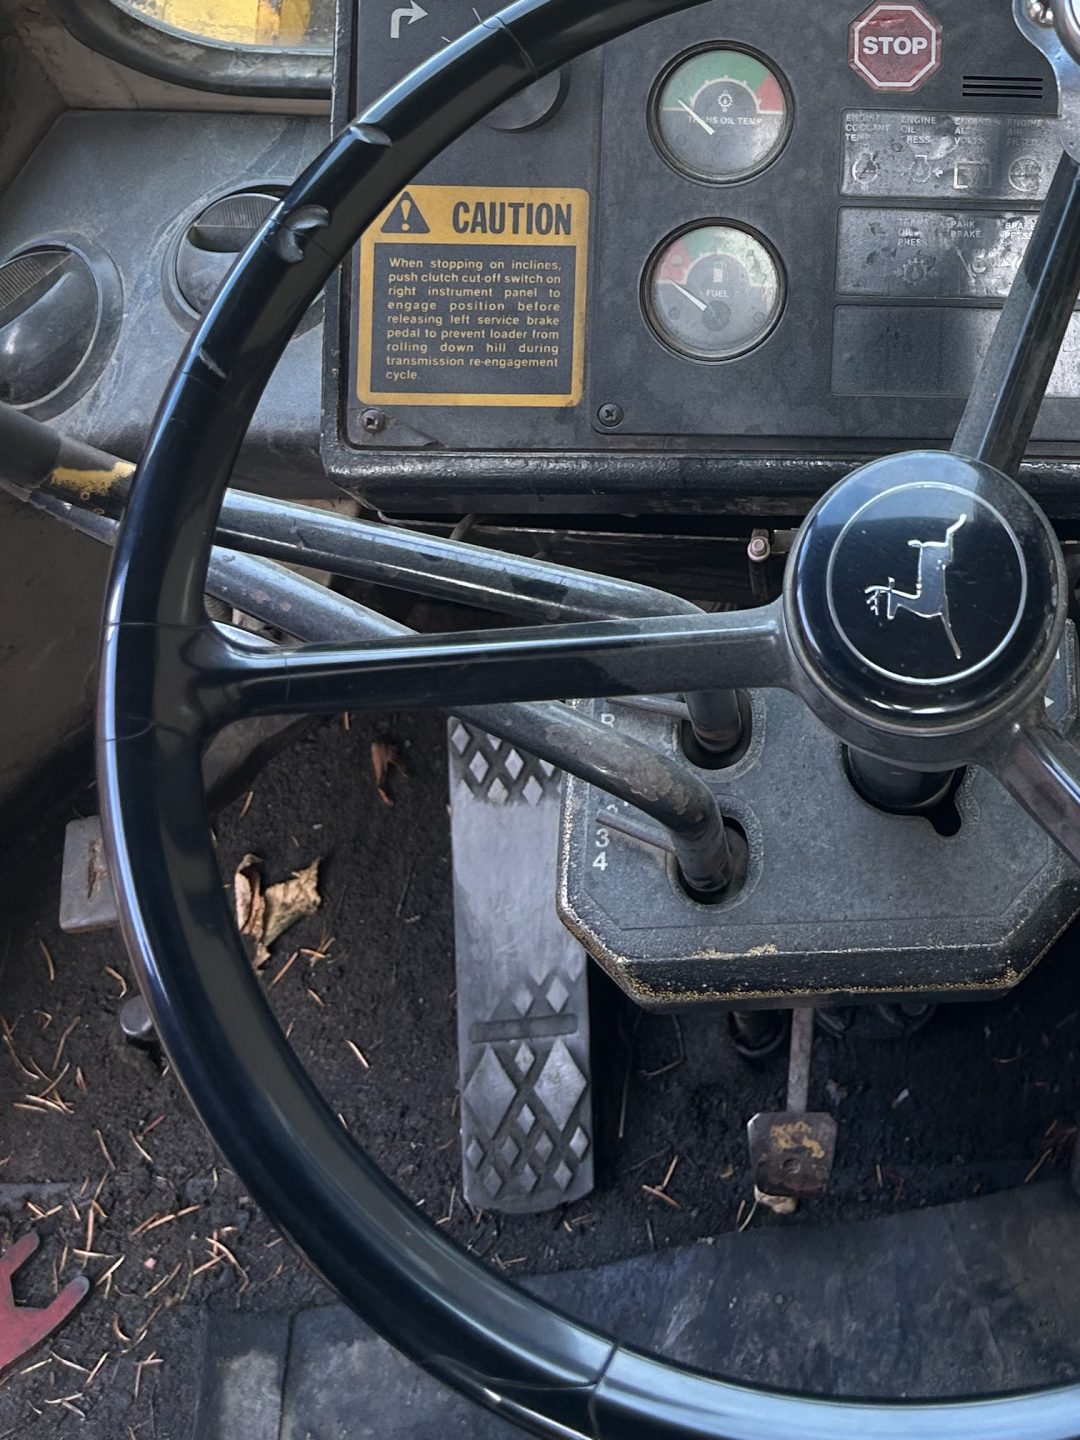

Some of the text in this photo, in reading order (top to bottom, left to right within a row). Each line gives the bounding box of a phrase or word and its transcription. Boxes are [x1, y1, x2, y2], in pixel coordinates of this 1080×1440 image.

[863, 36, 928, 55] STOP
[721, 116, 735, 124] OIL
[738, 117, 762, 125] TEMP
[900, 125, 916, 134] OIL
[452, 202, 572, 235] CAUTION
[951, 221, 976, 229] PARK
[951, 230, 981, 238] BRAKE
[389, 257, 562, 271] When stopping on inclines,
[388, 273, 561, 284] push clutch cut-off switch on
[388, 287, 560, 299] right instrument panel to
[706, 289, 729, 297] FUEL
[387, 301, 560, 313] engage position before
[387, 314, 560, 326] releasing left service brake
[387, 328, 559, 340] pedal to prevent loader from
[386, 342, 559, 355] rolling down hill during
[386, 356, 558, 369] transmission re-engagement
[386, 370, 421, 381] cycle.
[595, 828, 610, 848] 3
[592, 851, 609, 871] 4
